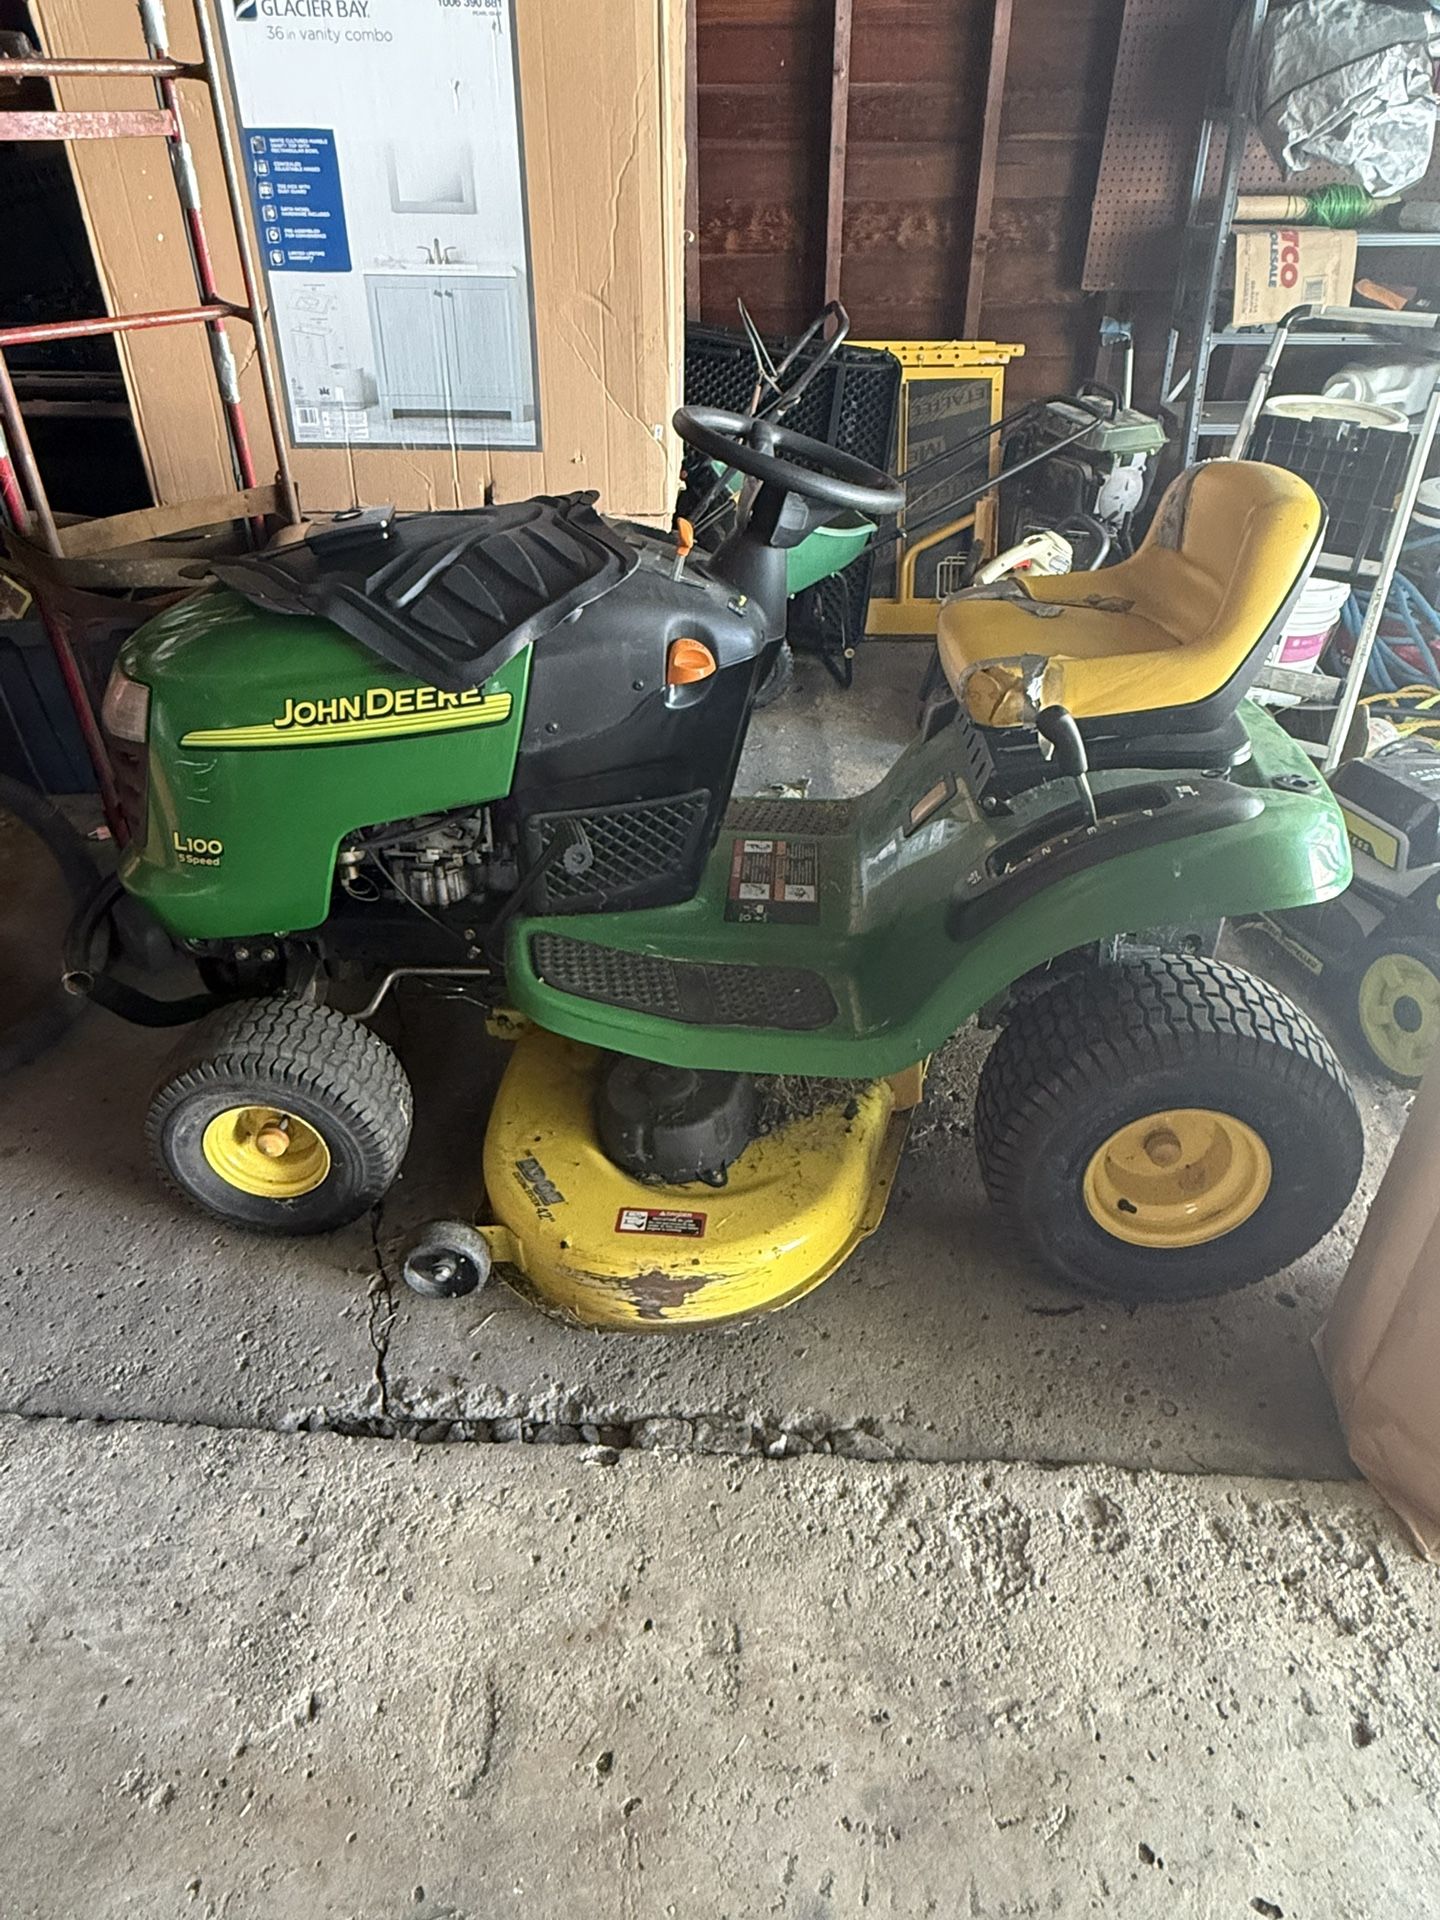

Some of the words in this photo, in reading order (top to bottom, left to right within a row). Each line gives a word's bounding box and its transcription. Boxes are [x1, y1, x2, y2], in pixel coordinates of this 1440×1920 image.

[261, 0, 334, 17] GLACIER
[266, 26, 285, 40] 36
[287, 30, 296, 40] in
[299, 27, 341, 44] vanity
[344, 28, 393, 42] combo
[274, 696, 361, 727] JOHN
[366, 686, 482, 717] DEERE
[173, 831, 223, 855] L100
[186, 854, 220, 866] Speed
